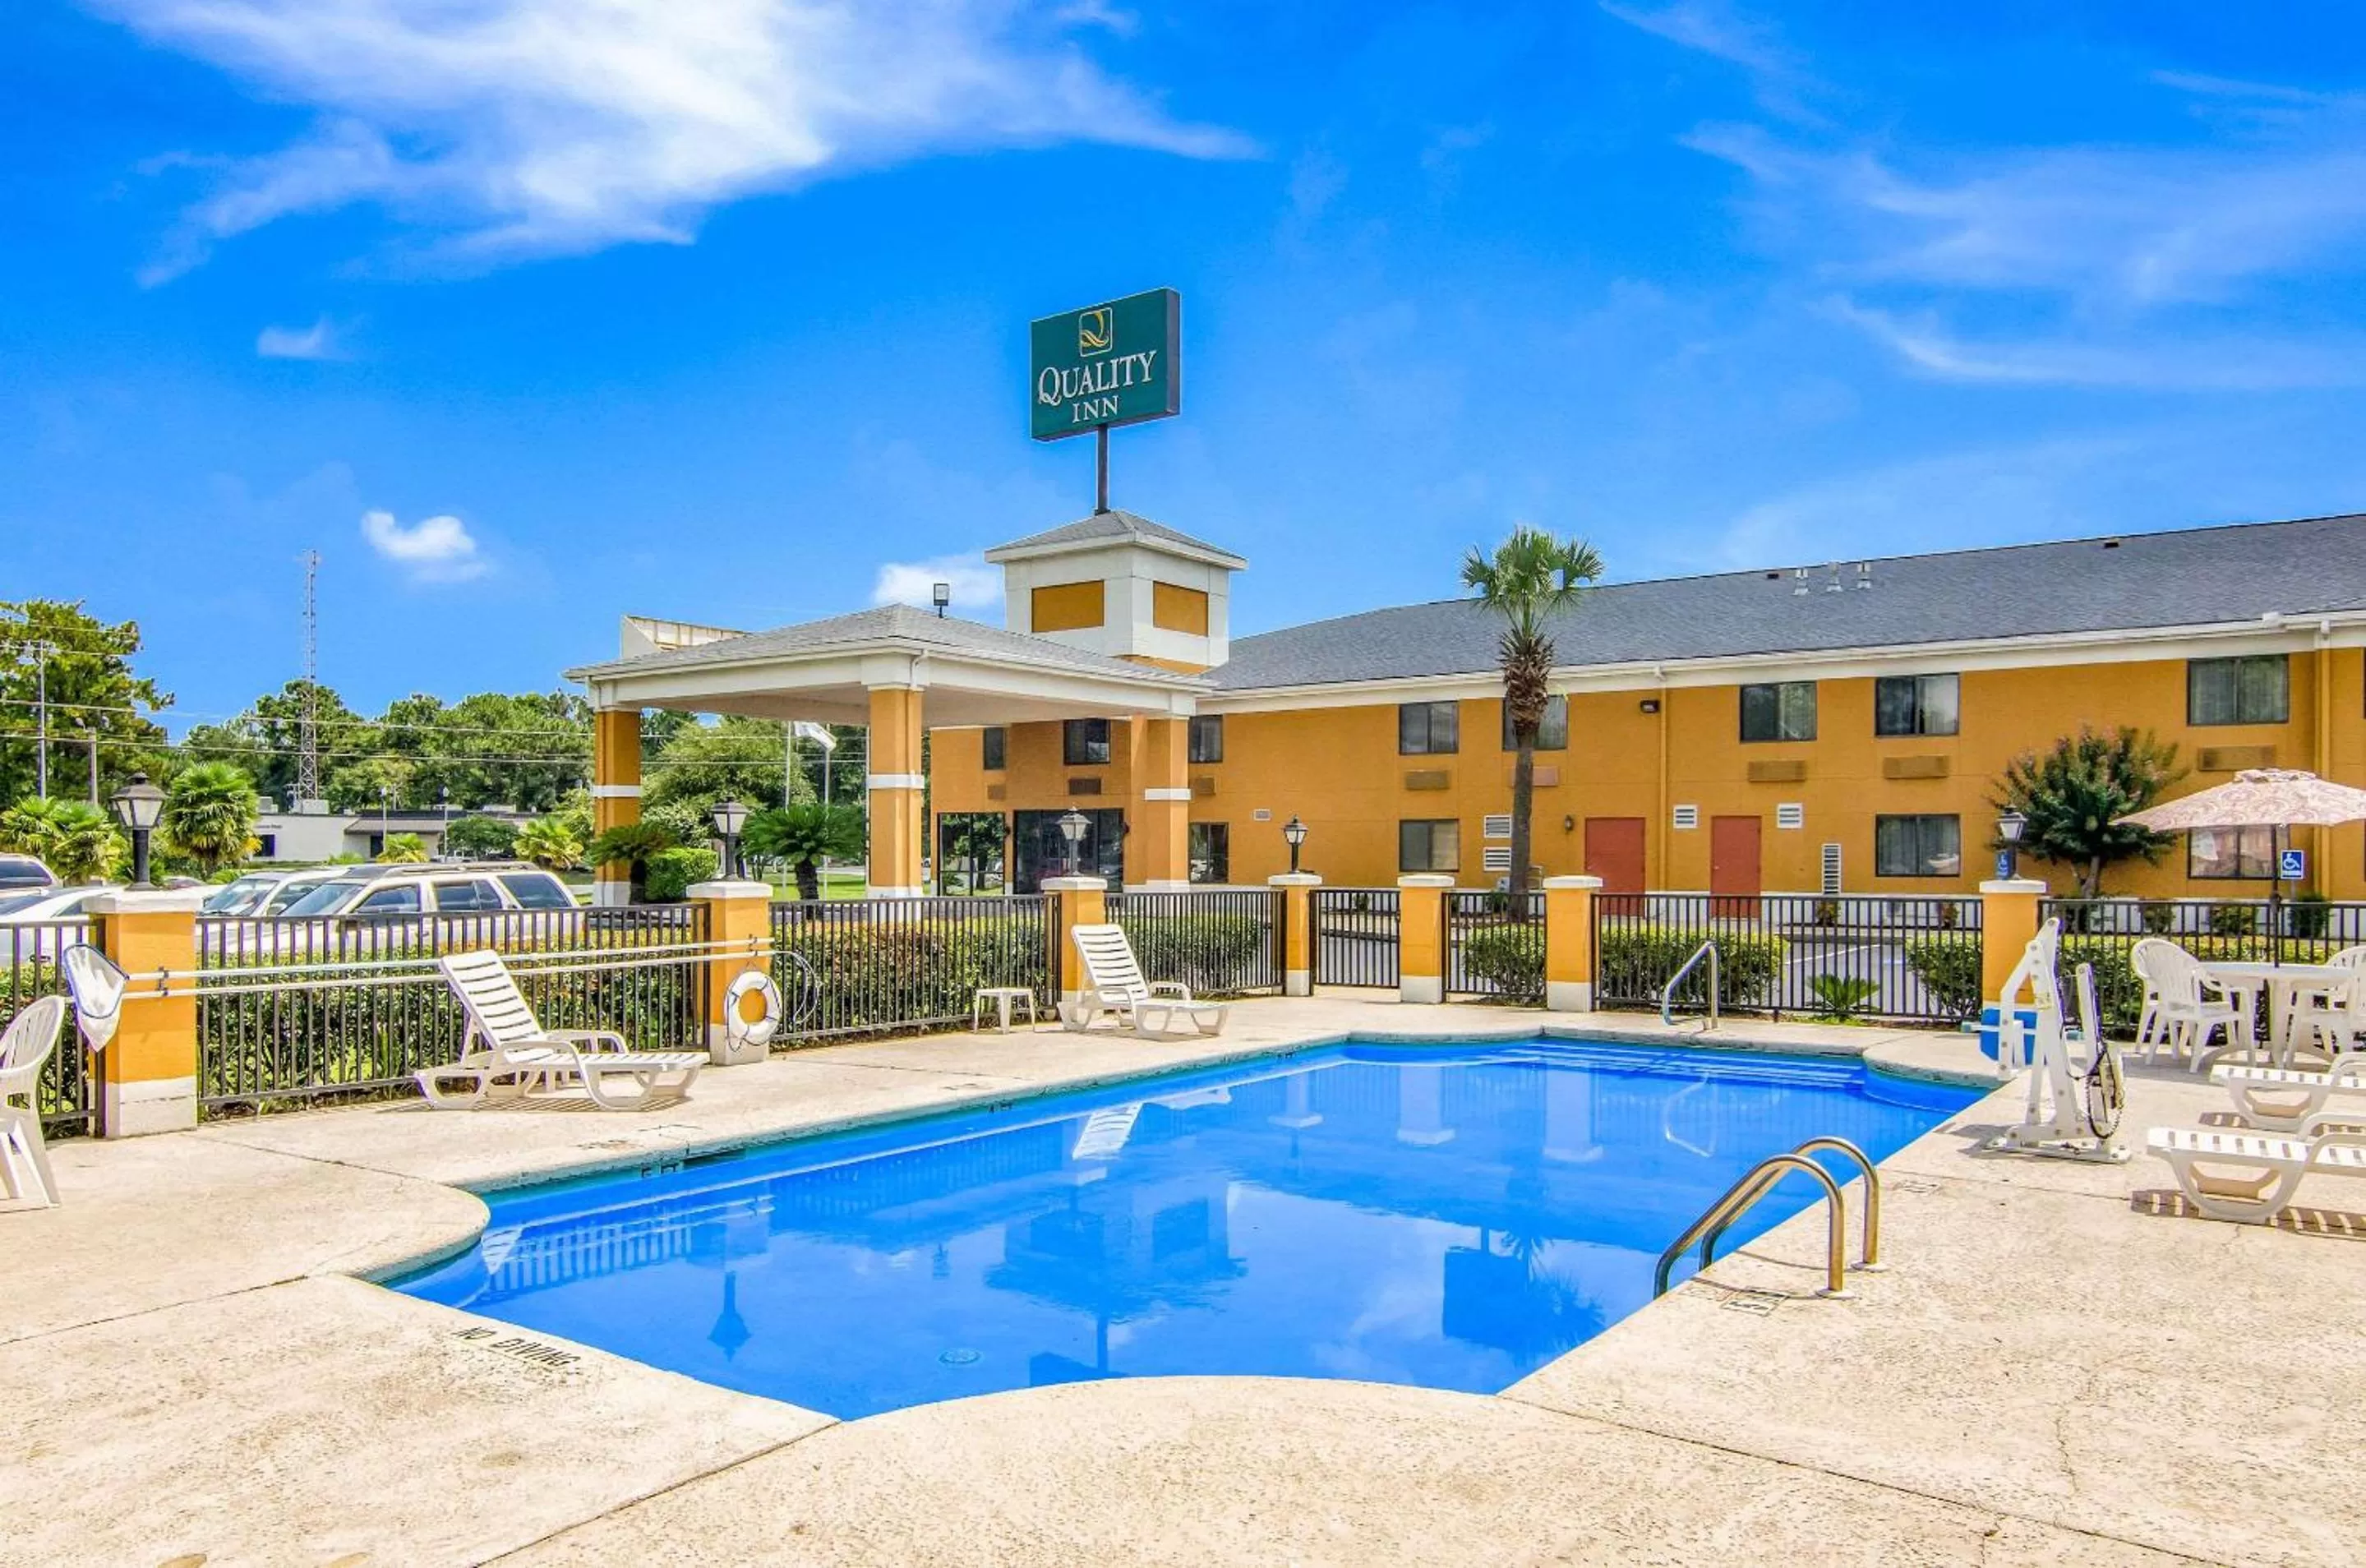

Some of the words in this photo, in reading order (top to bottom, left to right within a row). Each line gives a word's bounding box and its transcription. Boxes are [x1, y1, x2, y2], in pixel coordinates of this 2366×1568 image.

[1038, 350, 1157, 406] QUALITY
[1072, 395, 1118, 423] INN
[451, 1326, 497, 1340] NO
[490, 1338, 581, 1366] DIVING
